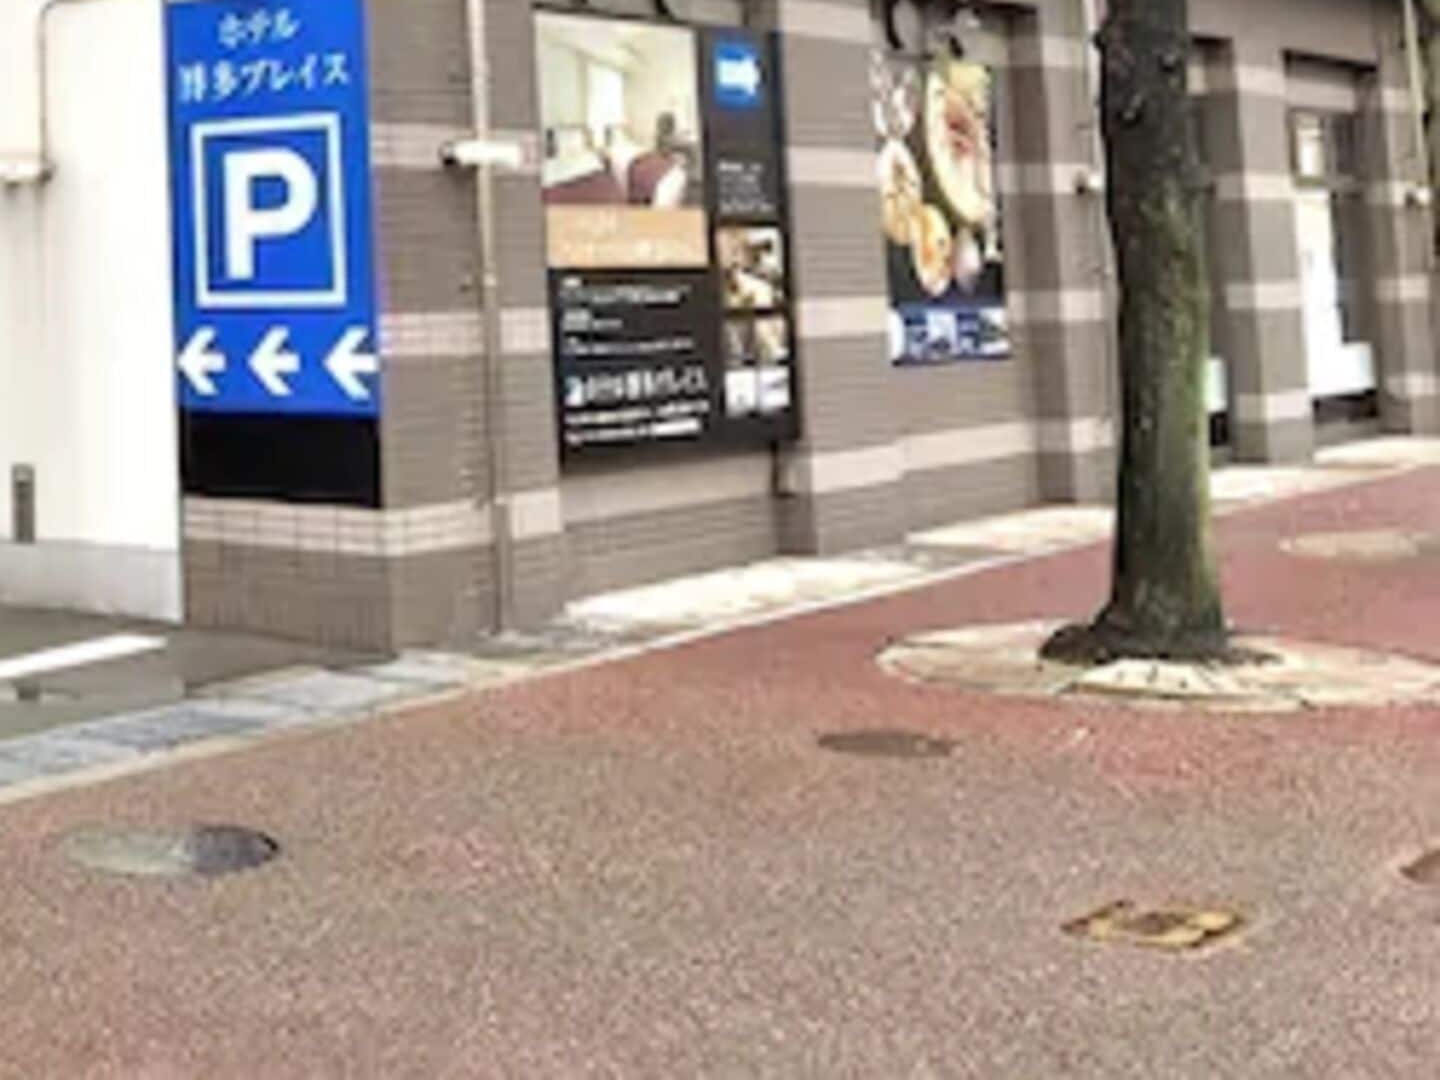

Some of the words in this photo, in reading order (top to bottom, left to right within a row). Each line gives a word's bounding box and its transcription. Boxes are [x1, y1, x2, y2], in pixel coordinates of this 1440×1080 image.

[218, 8, 300, 48] ホテル
[223, 147, 318, 280] P
